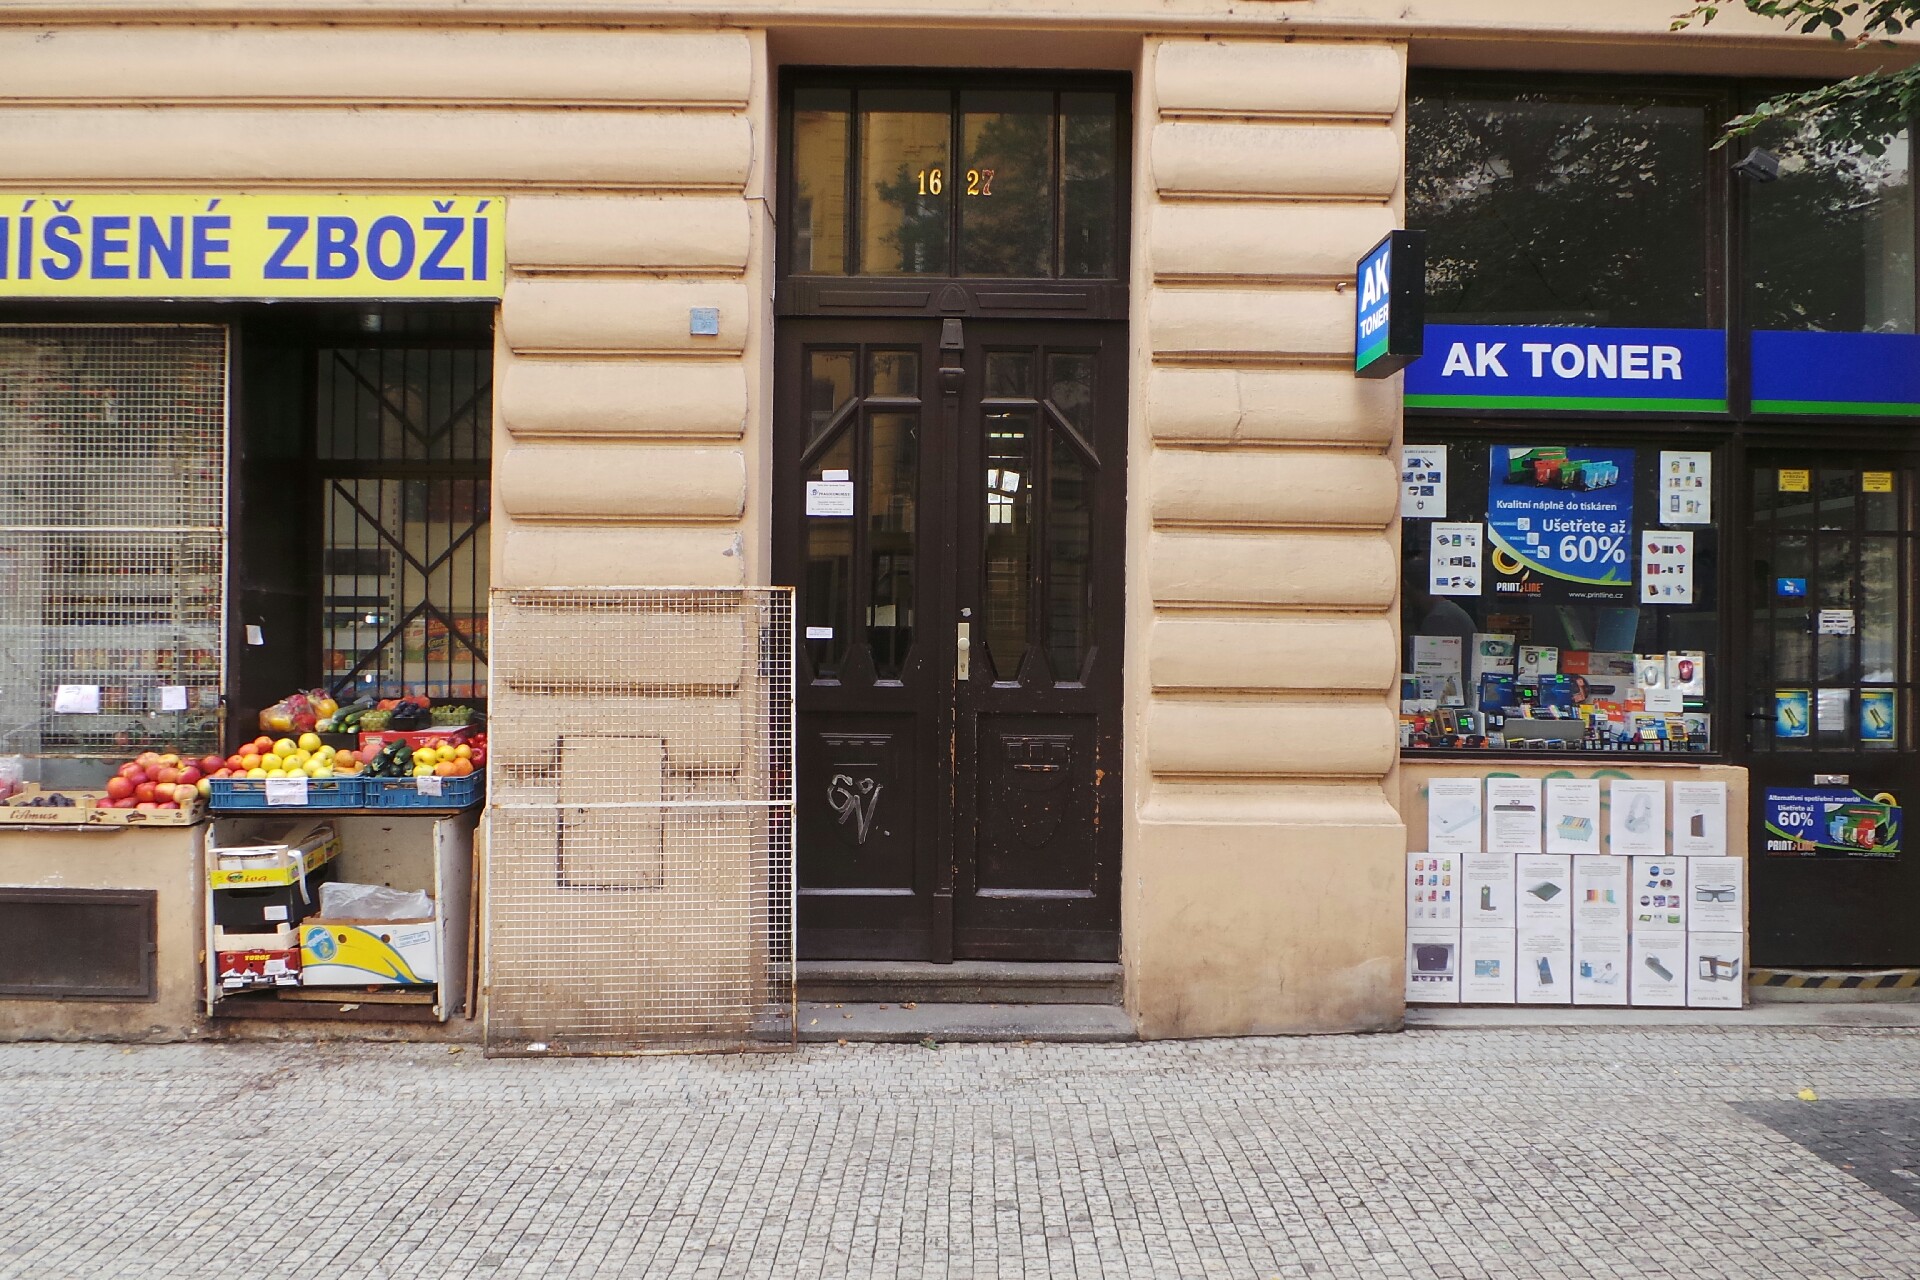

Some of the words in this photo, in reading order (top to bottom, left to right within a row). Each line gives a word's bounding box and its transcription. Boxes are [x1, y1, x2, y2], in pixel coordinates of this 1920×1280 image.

[917, 168, 943, 196] 16
[966, 169, 995, 196] 27
[0, 199, 232, 281] ÍŠENÉ
[263, 199, 489, 281] ZBOŽÍ
[1360, 250, 1390, 313] AK
[1359, 302, 1389, 339] TONER
[1440, 342, 1509, 378] AK
[1521, 342, 1683, 380] TONER
[1496, 499, 1532, 510] Kvalitní
[1532, 500, 1564, 512] náplně
[1566, 501, 1579, 511] do
[1580, 501, 1617, 512] tiskáren
[1542, 517, 1606, 533] Ušetřete
[1609, 519, 1626, 534] až
[1559, 534, 1626, 564] 60%
[1496, 581, 1520, 593] PRINT
[1568, 591, 1624, 600] www.printline.cz
[1778, 811, 1814, 827] 60%
[1767, 839, 1793, 852] PRINT
